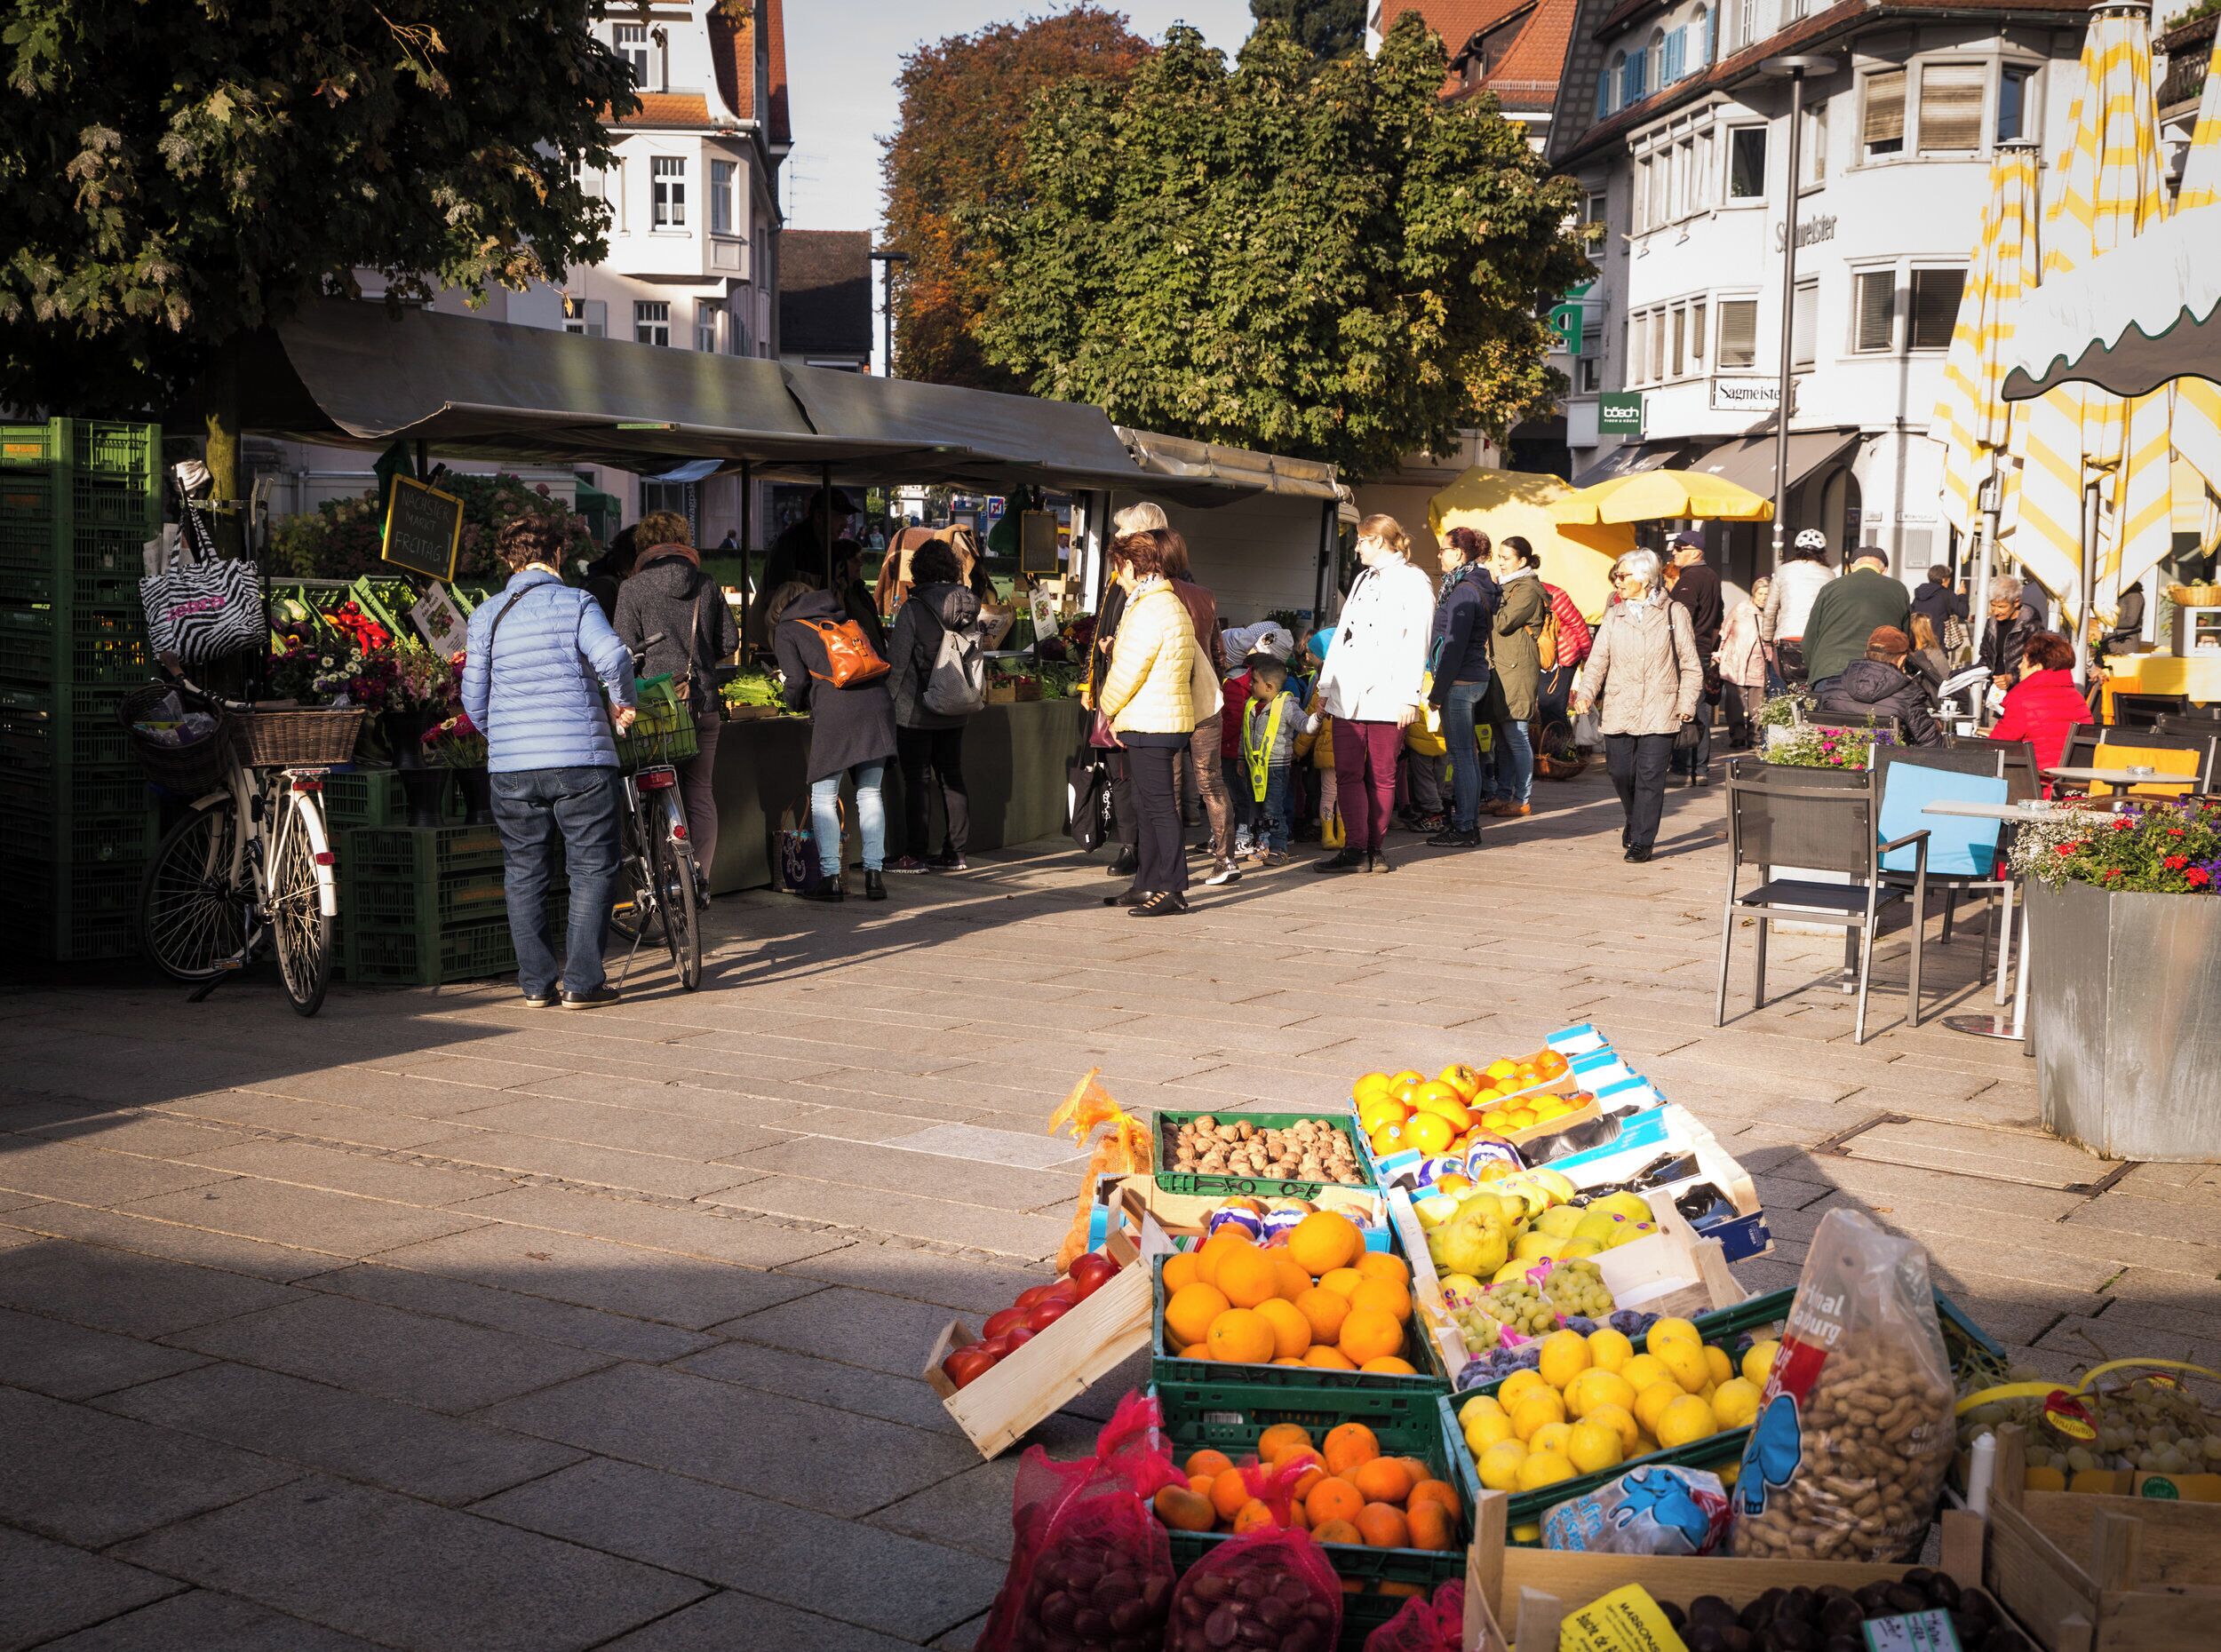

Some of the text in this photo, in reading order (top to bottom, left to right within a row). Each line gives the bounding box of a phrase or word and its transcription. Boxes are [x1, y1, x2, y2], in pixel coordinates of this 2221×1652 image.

[1776, 213, 1837, 253] Smeister
[1720, 384, 1781, 401] Sagmeiste
[166, 597, 226, 622] zebra
